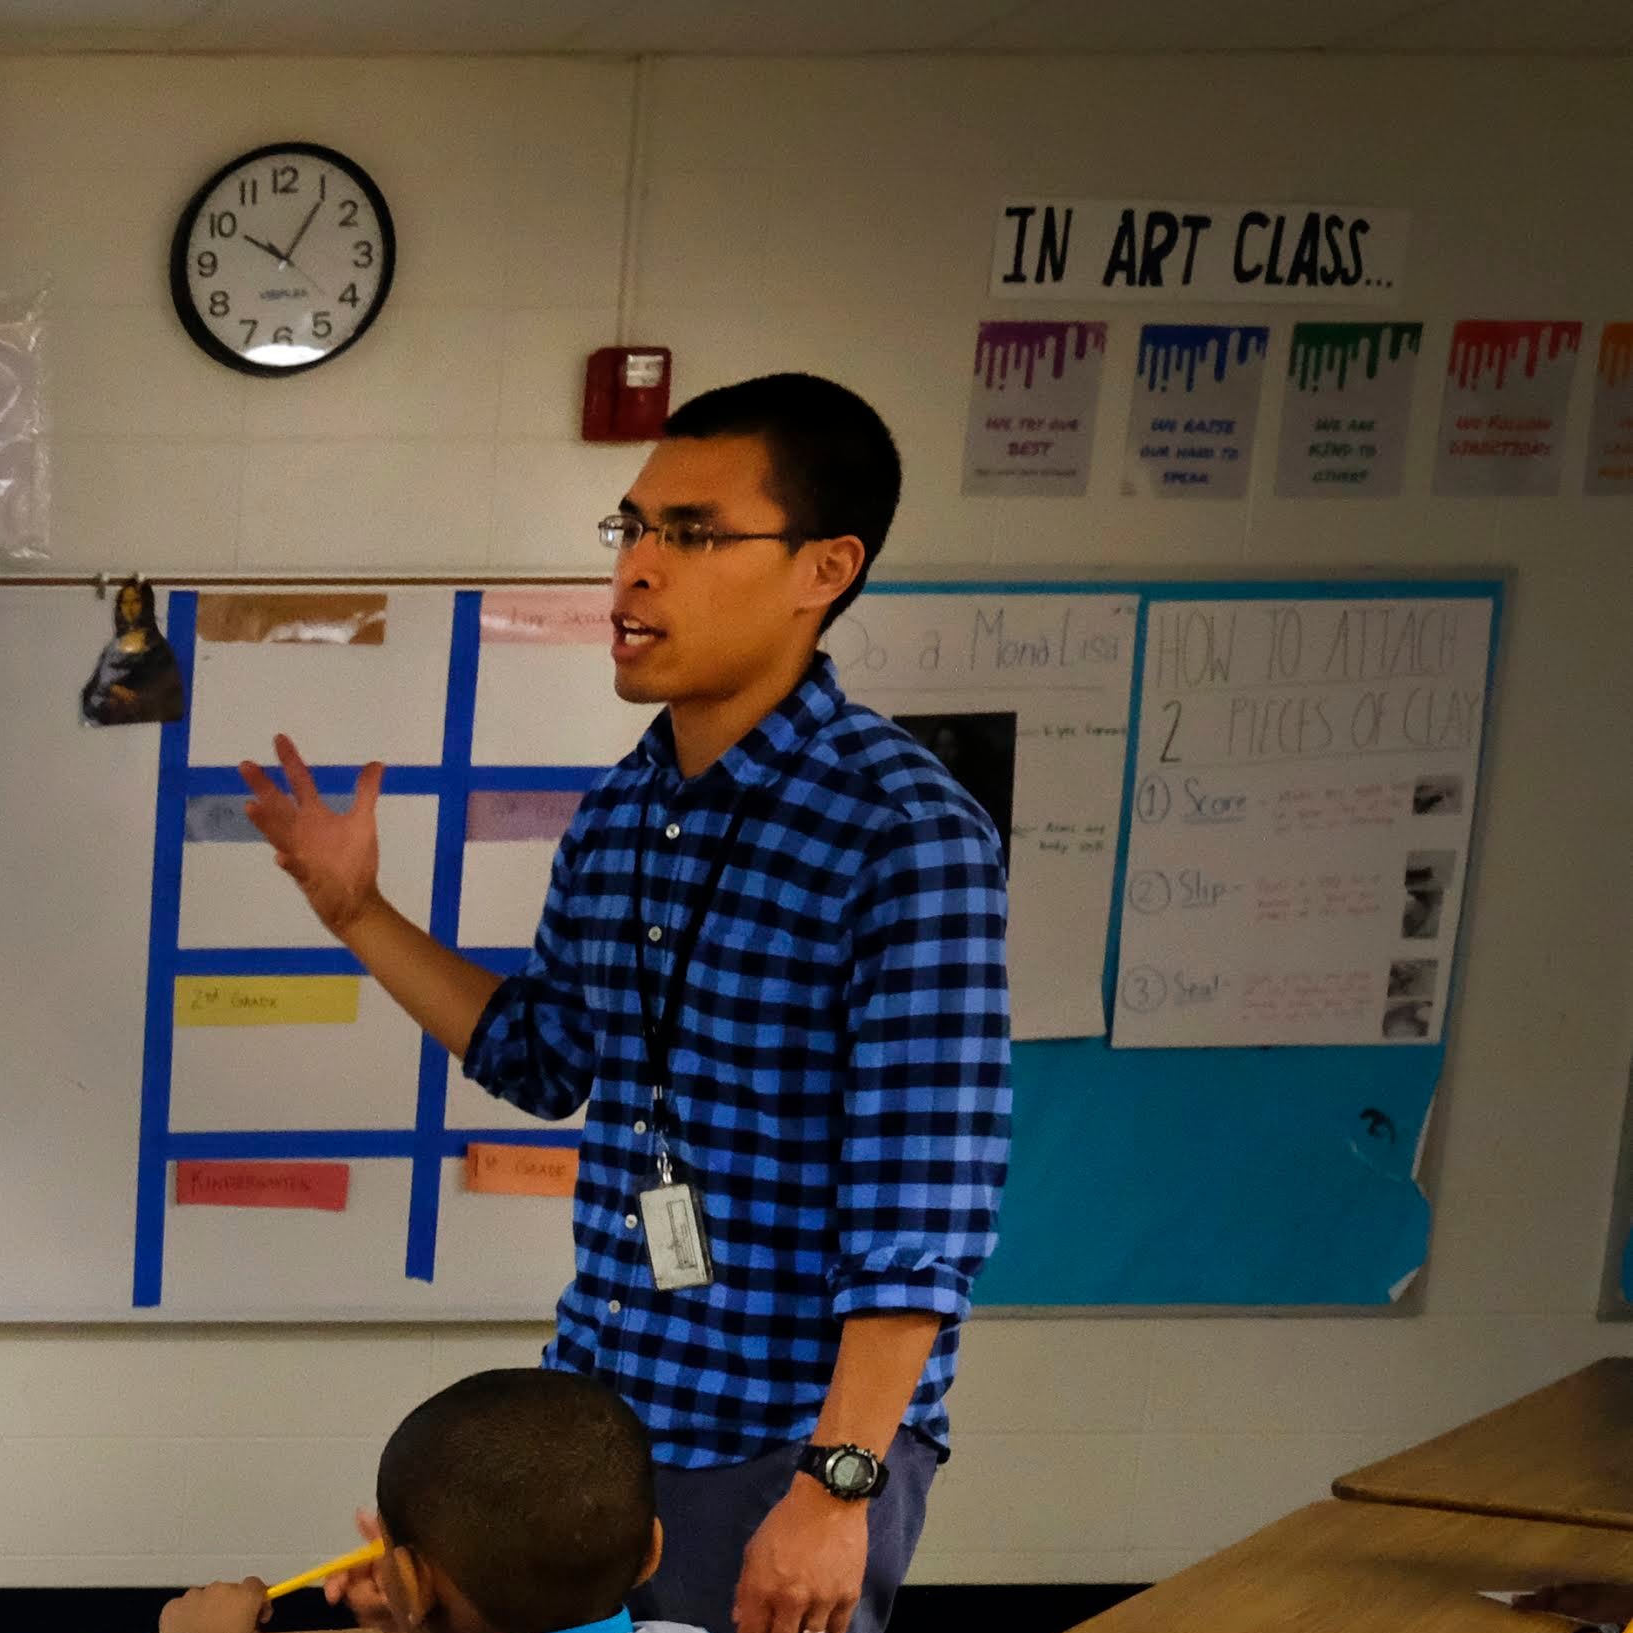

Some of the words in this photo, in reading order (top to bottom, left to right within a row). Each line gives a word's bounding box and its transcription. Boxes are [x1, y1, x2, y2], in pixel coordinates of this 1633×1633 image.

[238, 179, 259, 207] 11
[271, 165, 300, 195] 12
[319, 173, 327, 202] 1
[209, 211, 238, 239] 10
[337, 199, 359, 228] 2
[352, 239, 374, 269] 3
[1001, 205, 1074, 285] IN
[1101, 209, 1212, 288] ART
[1233, 210, 1394, 289] CLASS...
[197, 250, 218, 279] 9
[208, 290, 231, 317] 8
[337, 282, 361, 308] 4
[238, 318, 259, 345] 7
[272, 325, 294, 346] 6
[311, 311, 333, 339] 5
[1007, 440, 1055, 457] BEST
[970, 607, 1050, 672] Mona
[1157, 608, 1237, 687] HOW
[1265, 607, 1302, 680] TO
[1324, 607, 1458, 680] ATTACH
[1160, 700, 1183, 763] 2
[1228, 697, 1336, 756] PIECES
[1403, 687, 1483, 745] CLAY
